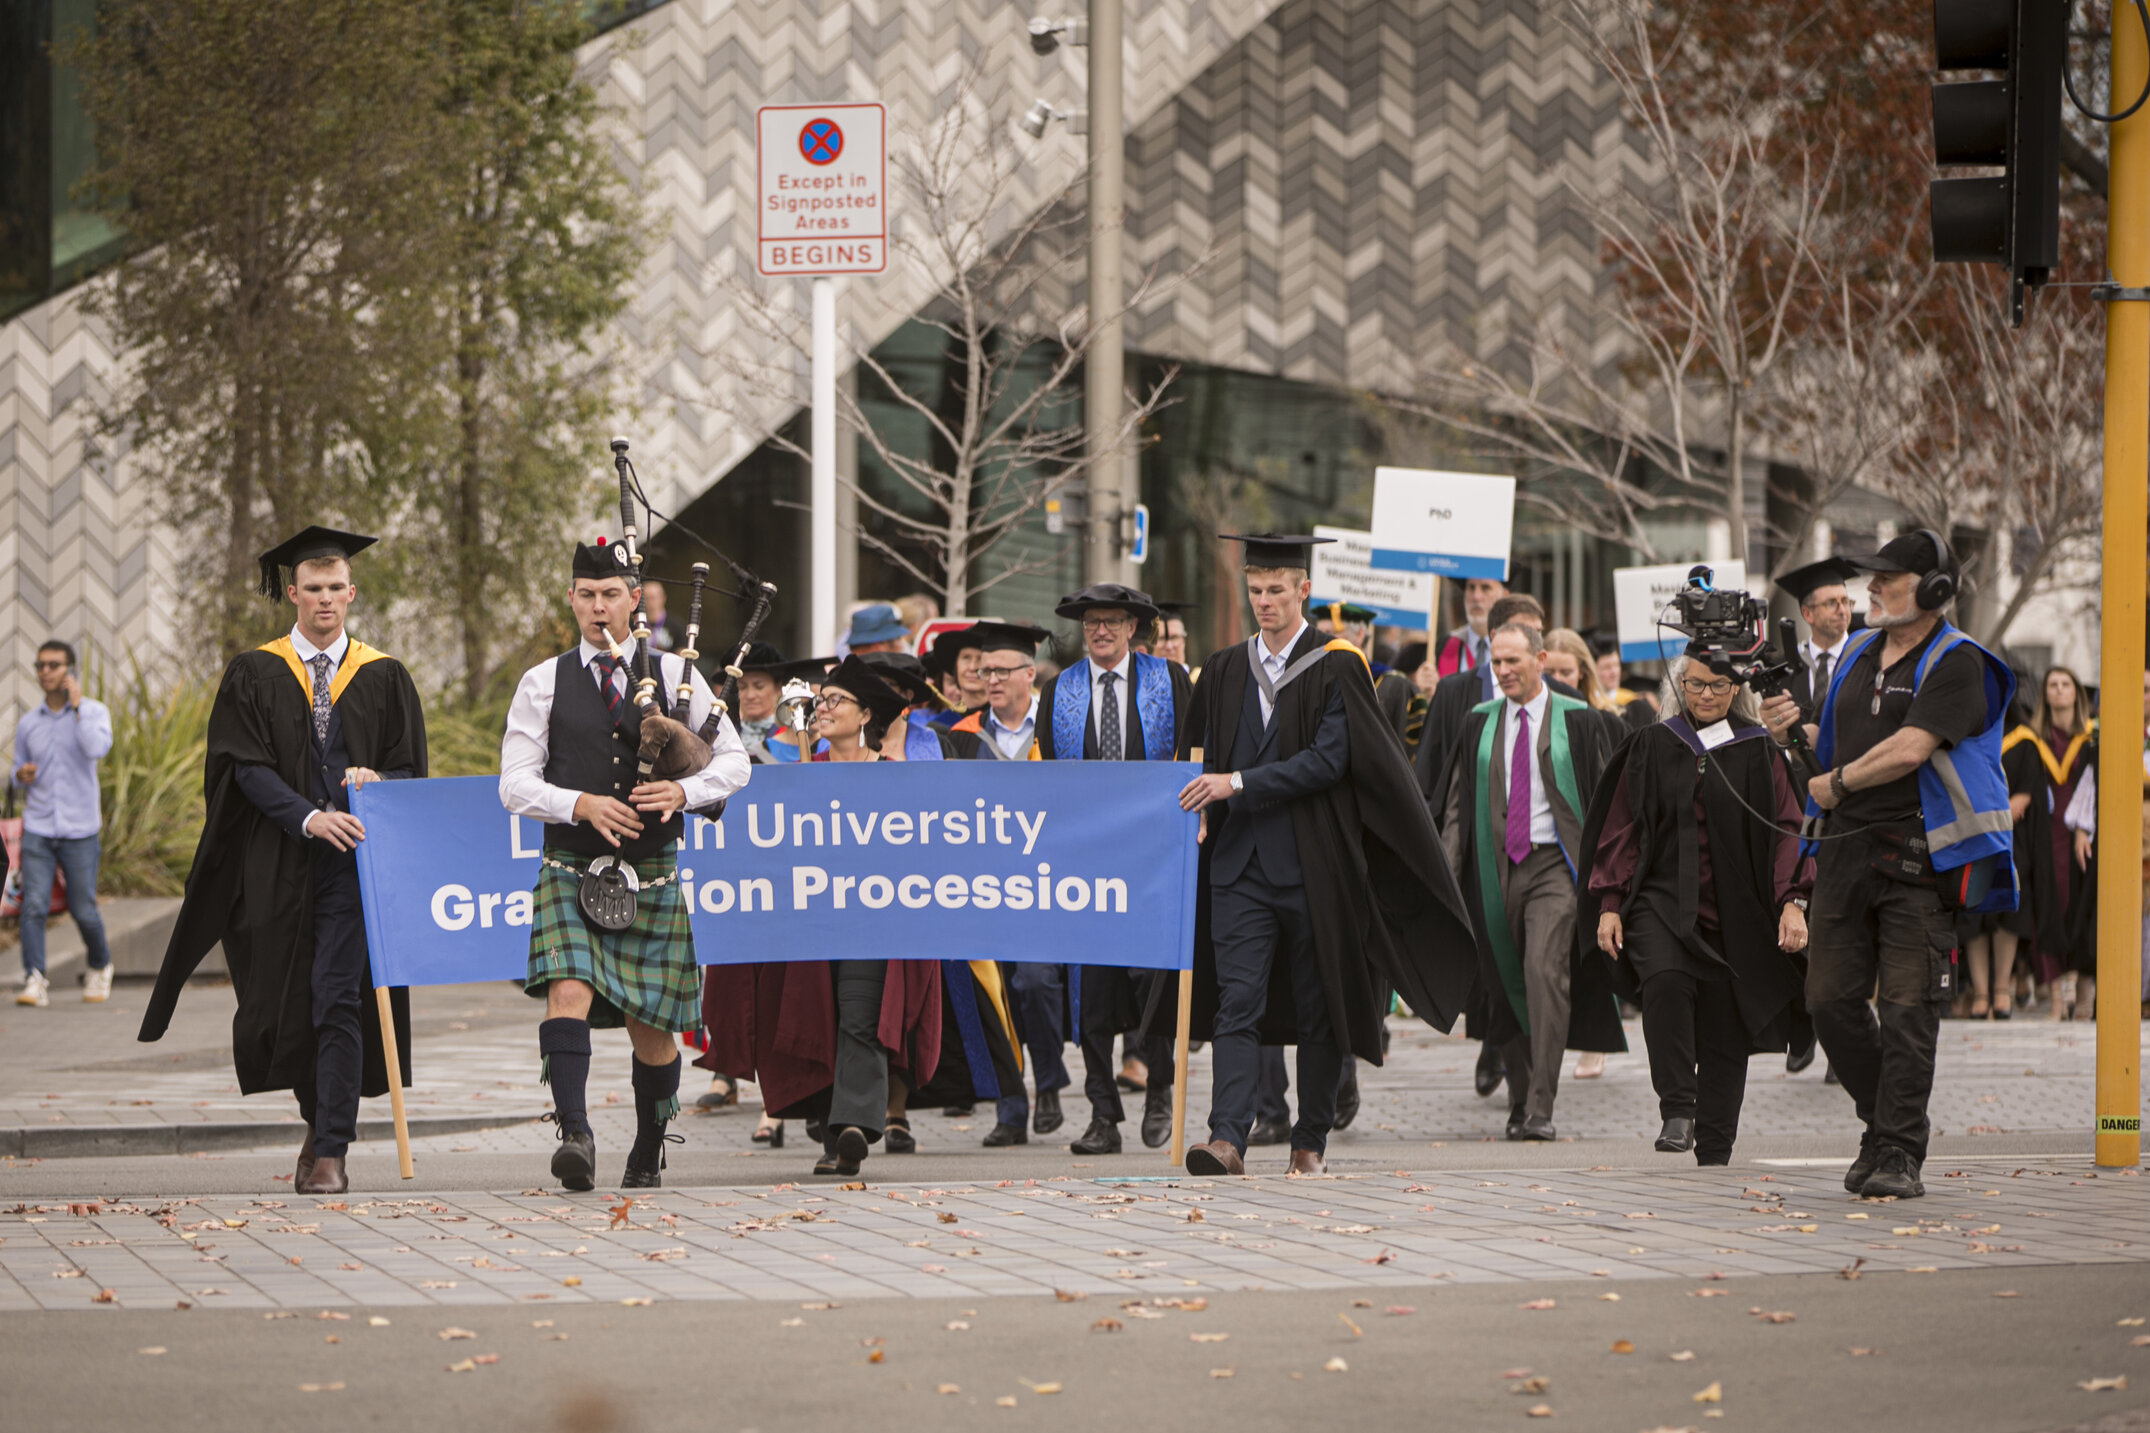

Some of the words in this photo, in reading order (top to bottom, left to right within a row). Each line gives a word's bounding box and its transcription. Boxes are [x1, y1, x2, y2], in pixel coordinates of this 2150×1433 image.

[778, 174, 844, 191] Except
[850, 173, 867, 187] in
[768, 193, 877, 212] Signposted
[795, 215, 850, 230] Areas
[771, 244, 872, 265] BEGINS
[1428, 507, 1452, 520] PhD
[1326, 567, 1405, 587] Management
[1340, 583, 1401, 604] Marketing
[747, 798, 1047, 855] University
[430, 865, 774, 932] Graion
[792, 862, 1128, 913] Procession
[2101, 1118, 2140, 1131] DANGE
